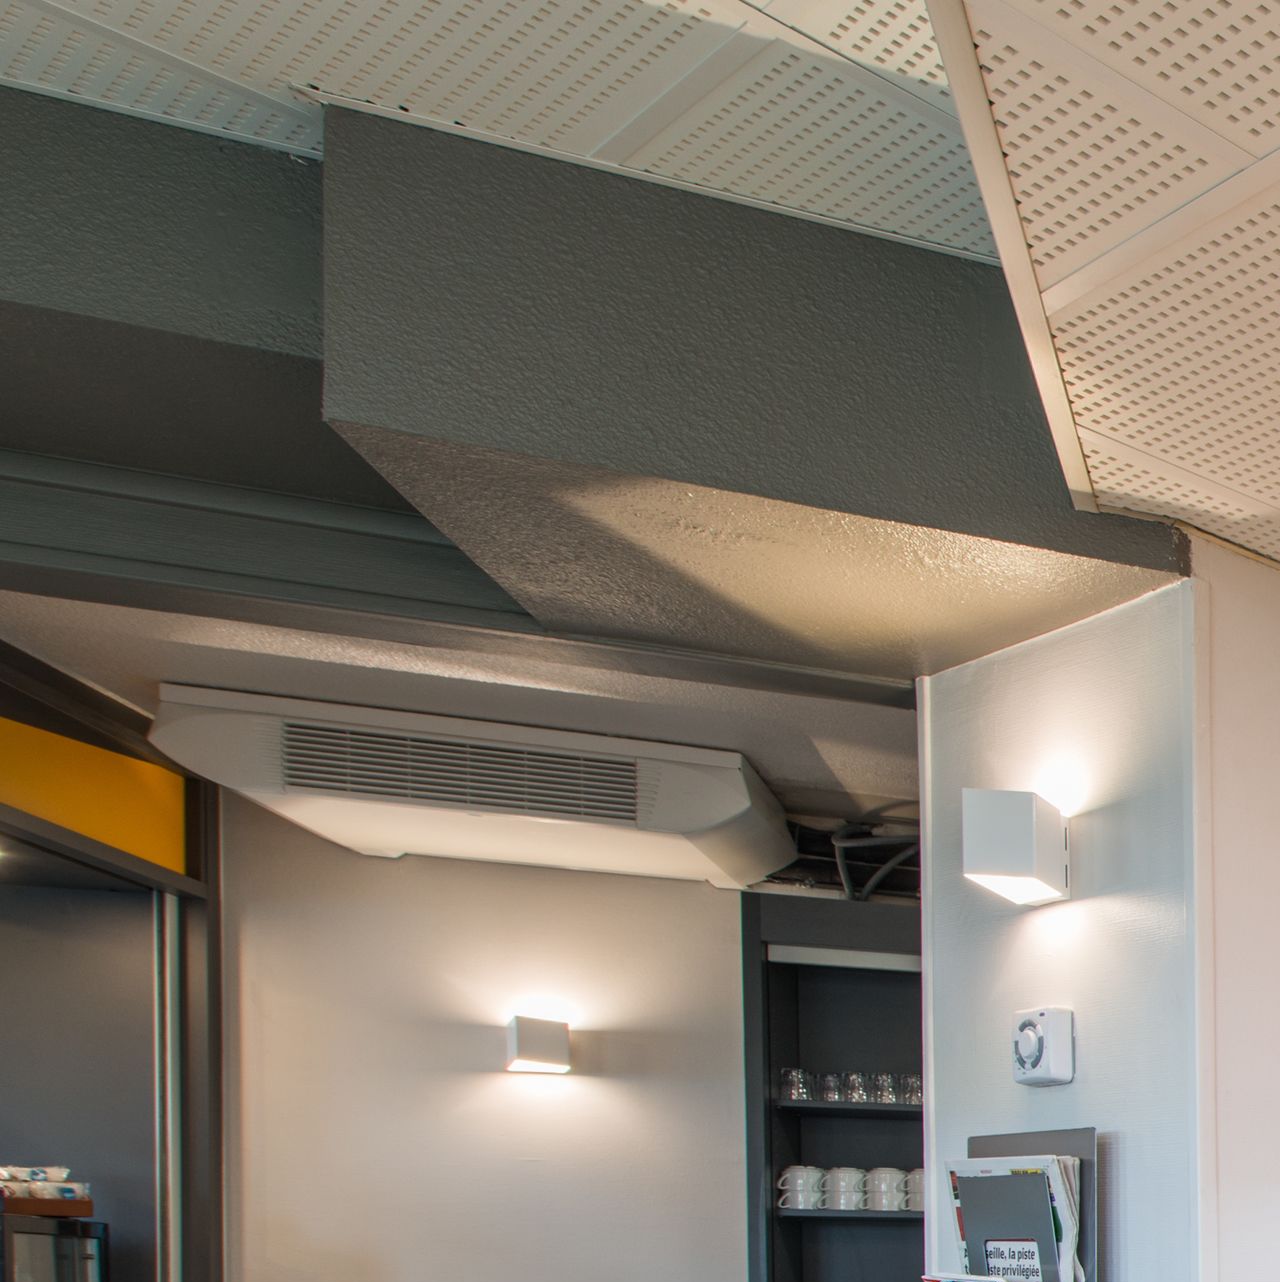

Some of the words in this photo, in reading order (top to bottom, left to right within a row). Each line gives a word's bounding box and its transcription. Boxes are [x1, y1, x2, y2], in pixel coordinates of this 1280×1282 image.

[1008, 1247, 1016, 1260] la
[1017, 1247, 1035, 1262] piste
[1001, 1263, 1040, 1280] privilégiée
